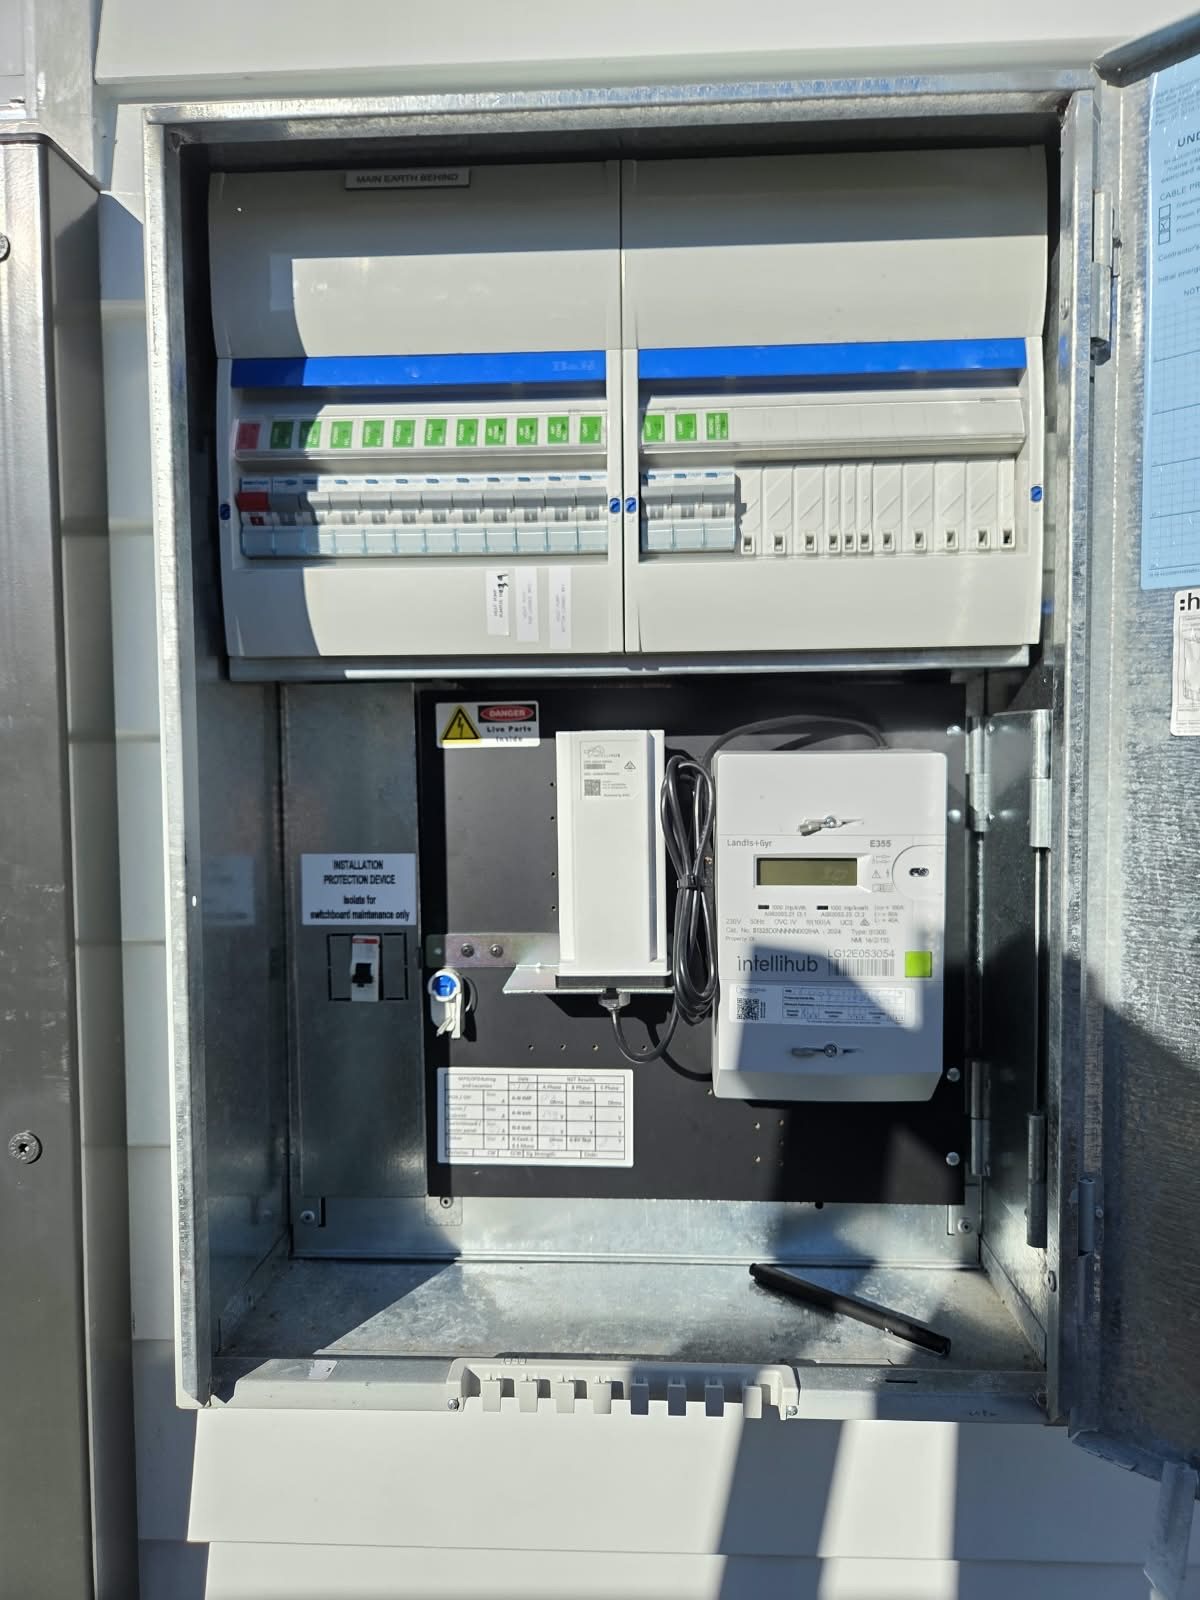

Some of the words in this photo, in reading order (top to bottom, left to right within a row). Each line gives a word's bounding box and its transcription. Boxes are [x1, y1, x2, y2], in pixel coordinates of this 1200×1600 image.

[357, 175, 381, 183] MAIN
[383, 173, 418, 183] EARTH
[419, 172, 459, 183] BEHIND
[1160, 186, 1185, 201] CABLE
[490, 709, 525, 718] DANGER
[487, 725, 505, 733] Live
[727, 839, 773, 848] Landis+Gyr
[869, 839, 892, 848] E355
[333, 859, 384, 870] INSTALLATION
[323, 874, 369, 885] PROTECTION
[370, 874, 396, 885] DEVICE
[366, 895, 377, 905] for
[310, 909, 351, 921] switchboard
[352, 909, 394, 920] maintenance
[395, 909, 410, 922] only
[828, 949, 895, 958] LG12E053054
[737, 955, 818, 973] intellihub
